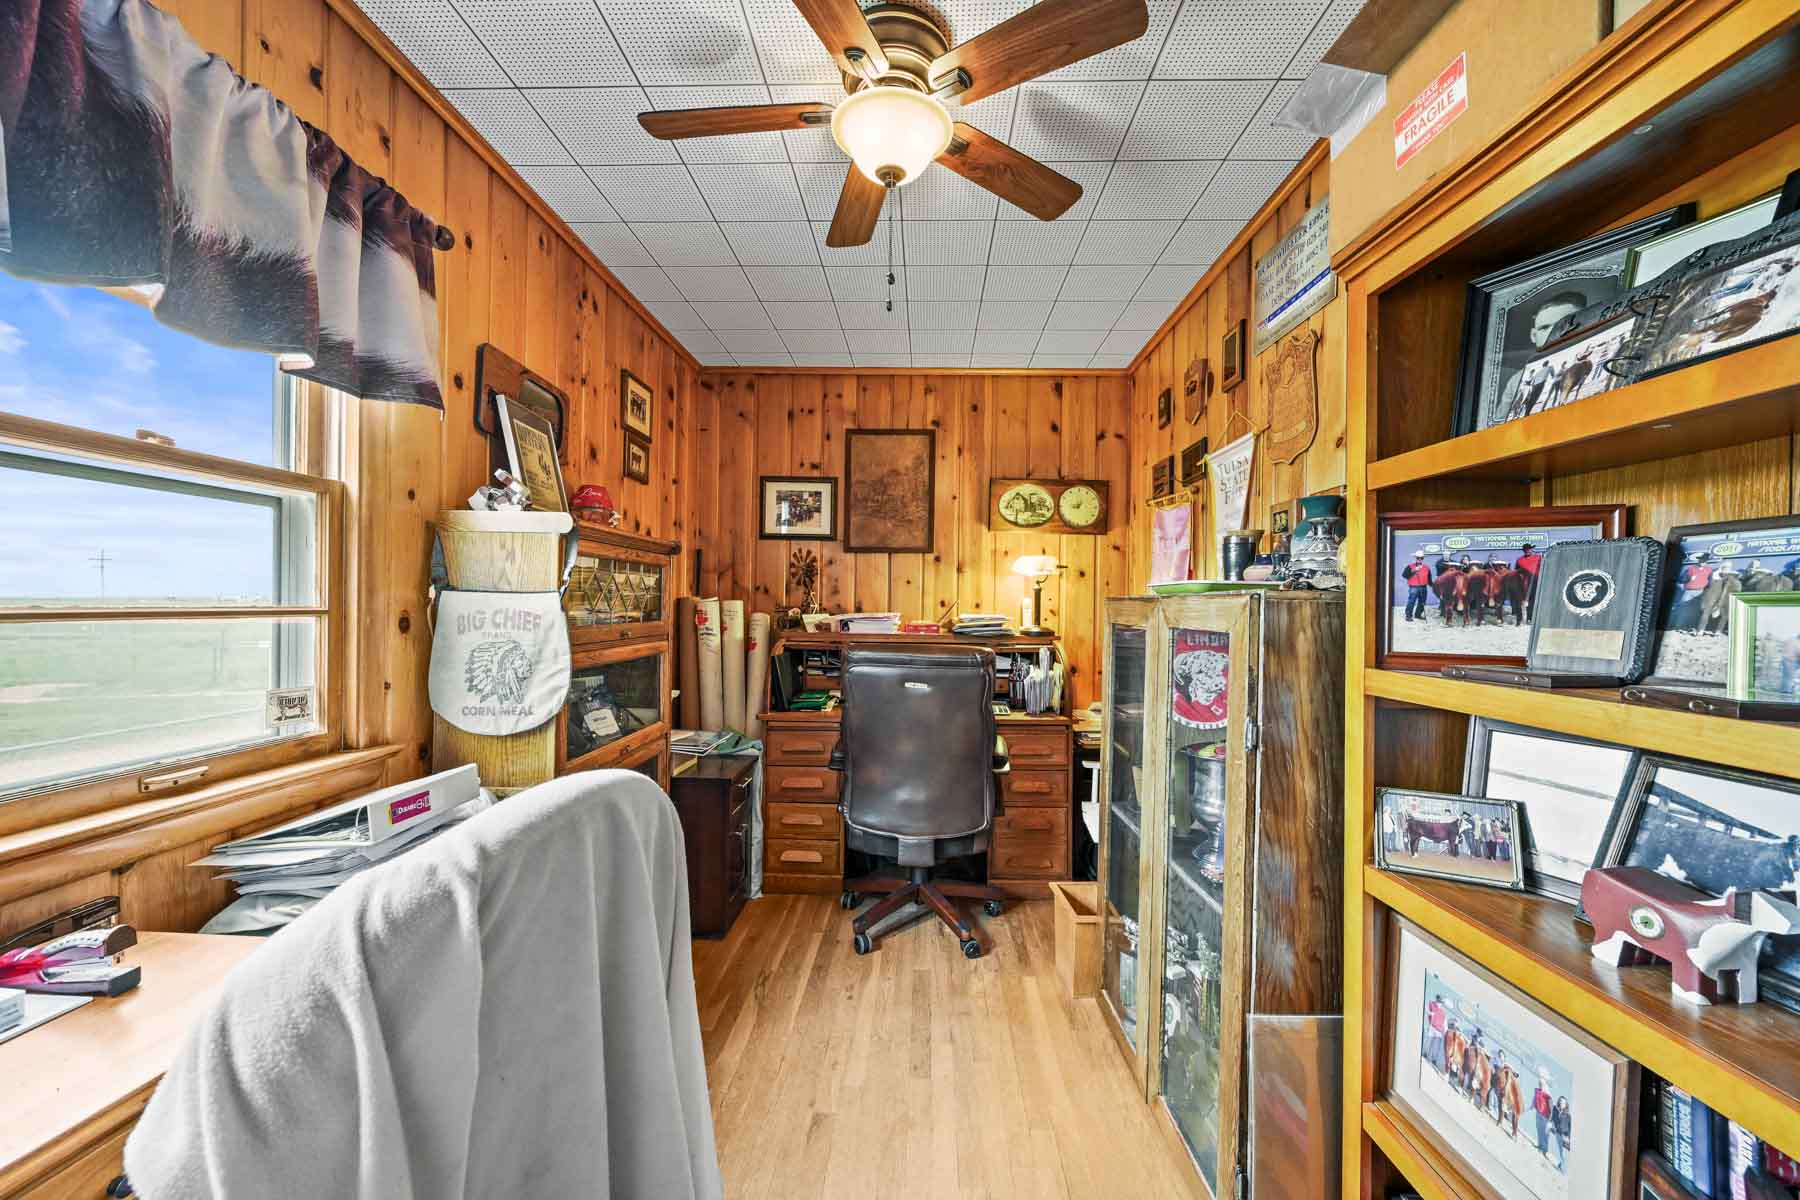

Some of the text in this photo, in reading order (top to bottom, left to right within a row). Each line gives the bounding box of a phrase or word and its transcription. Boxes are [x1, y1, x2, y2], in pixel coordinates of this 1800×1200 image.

[1403, 88, 1456, 145] FRAGILE
[1217, 455, 1249, 481] TULSA
[456, 608, 542, 635] BIG CHIEF
[482, 632, 512, 640] BRAND
[462, 704, 535, 717] CORN MEAL
